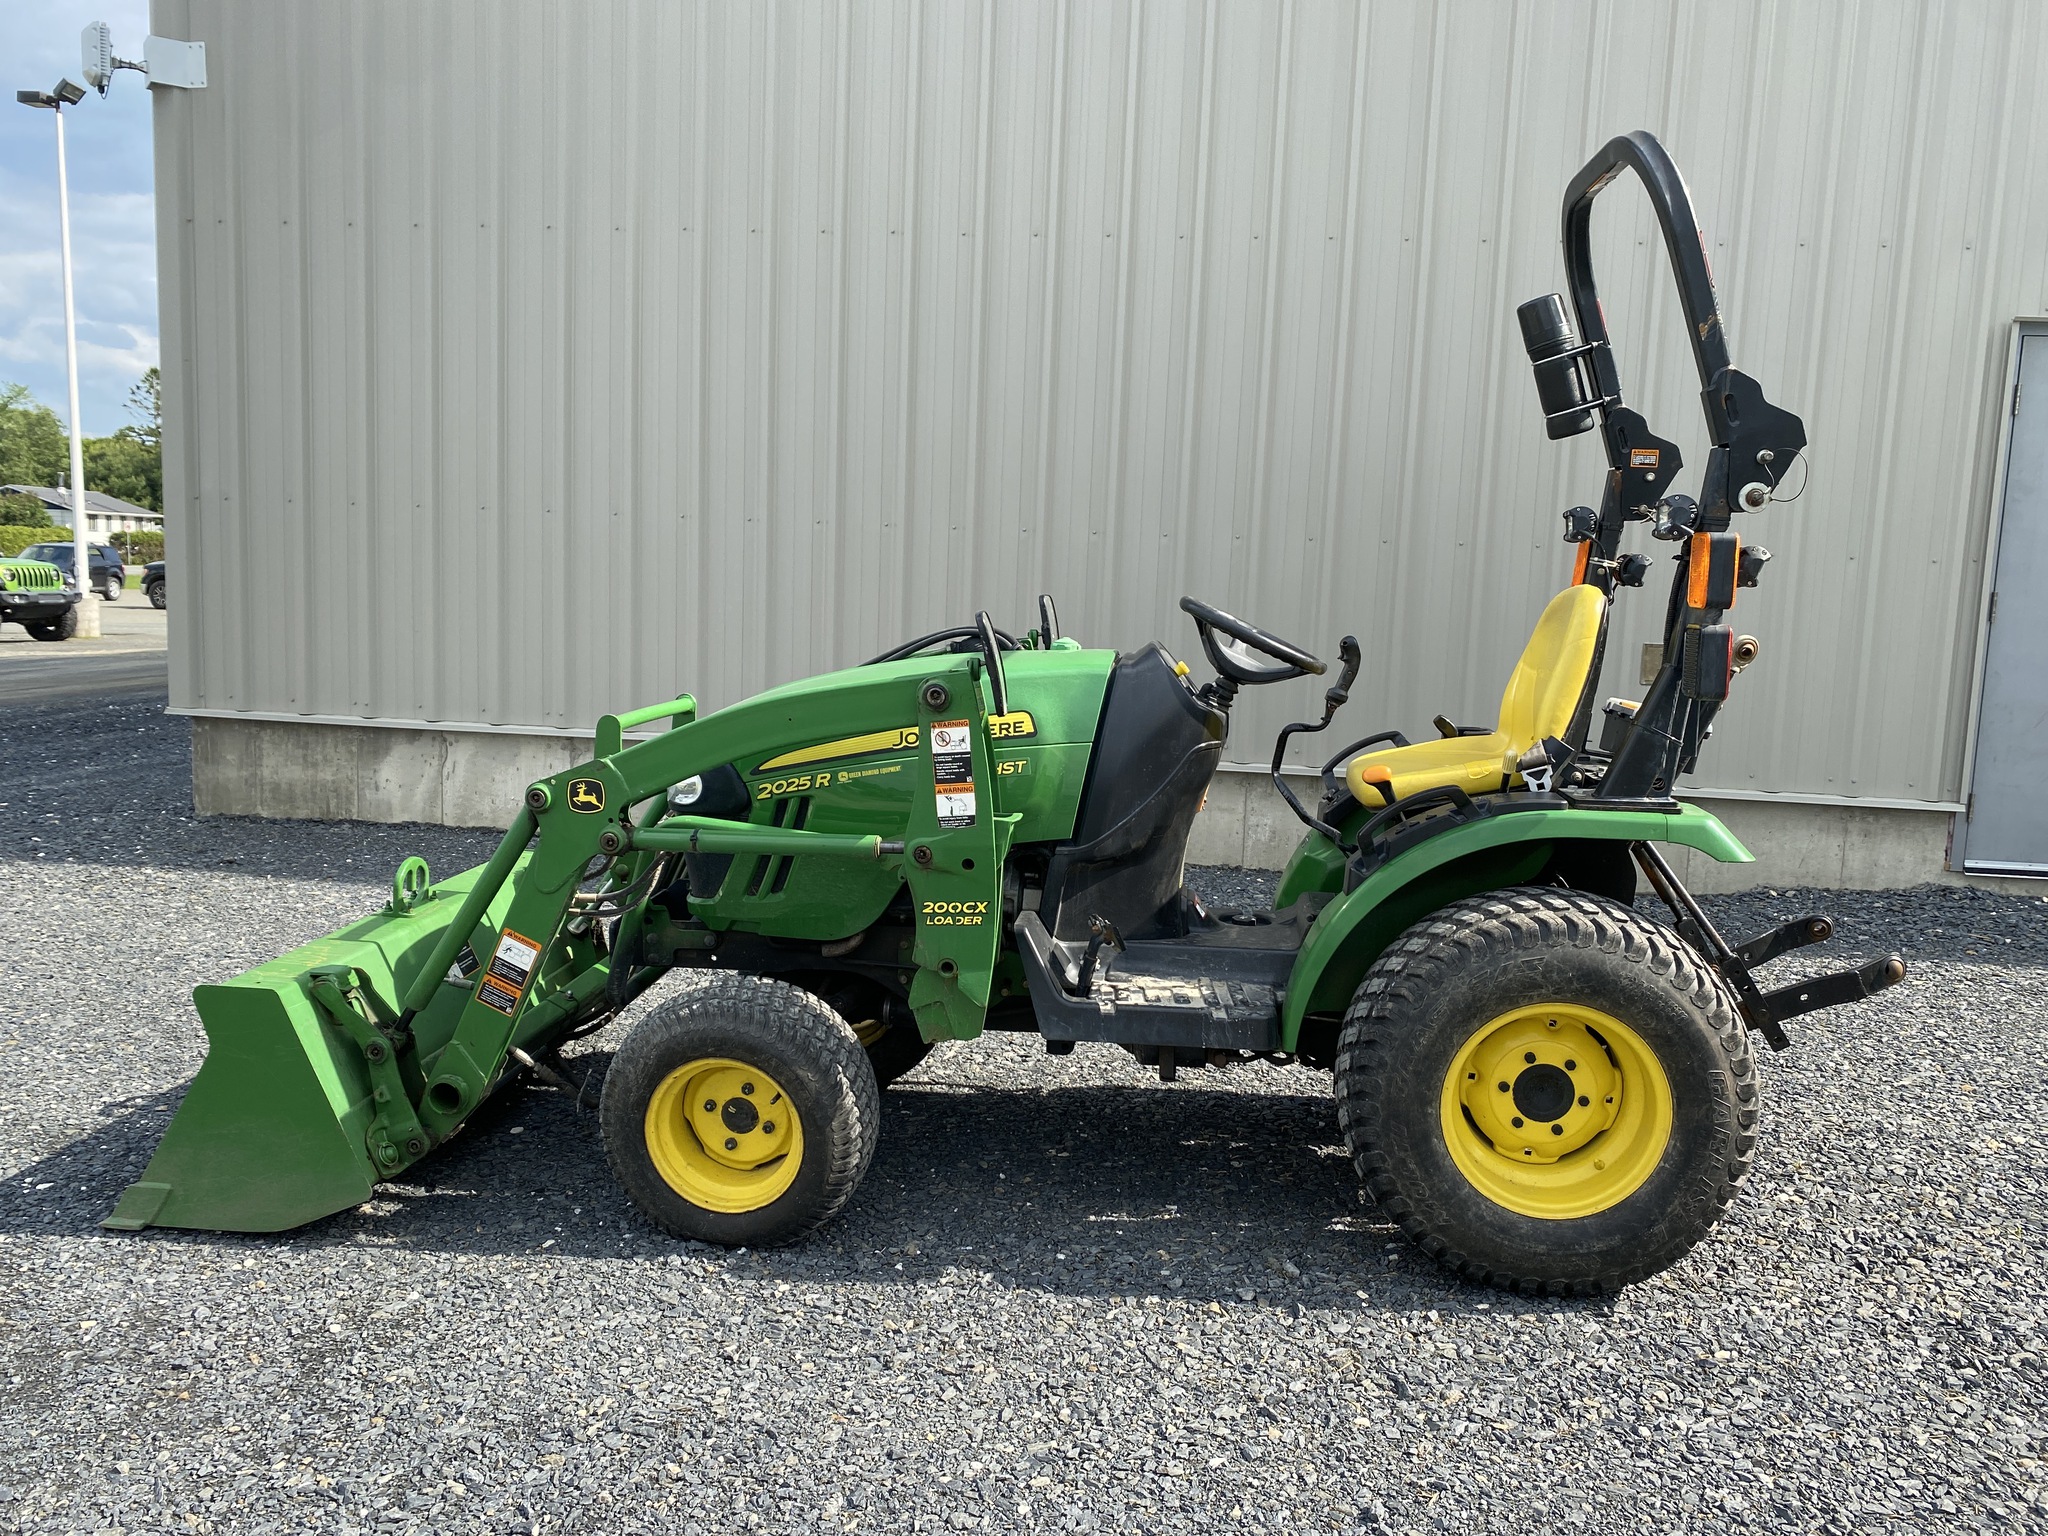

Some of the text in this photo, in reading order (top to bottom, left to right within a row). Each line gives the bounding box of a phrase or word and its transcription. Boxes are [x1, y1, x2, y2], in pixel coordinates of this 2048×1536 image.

[880, 765, 902, 774] EQUIPMENT
[757, 773, 832, 800] 2025 R
[922, 902, 988, 913] 200CX
[926, 916, 982, 925] LOADER
[513, 933, 537, 949] WARNING
[493, 980, 517, 996] WARNING
